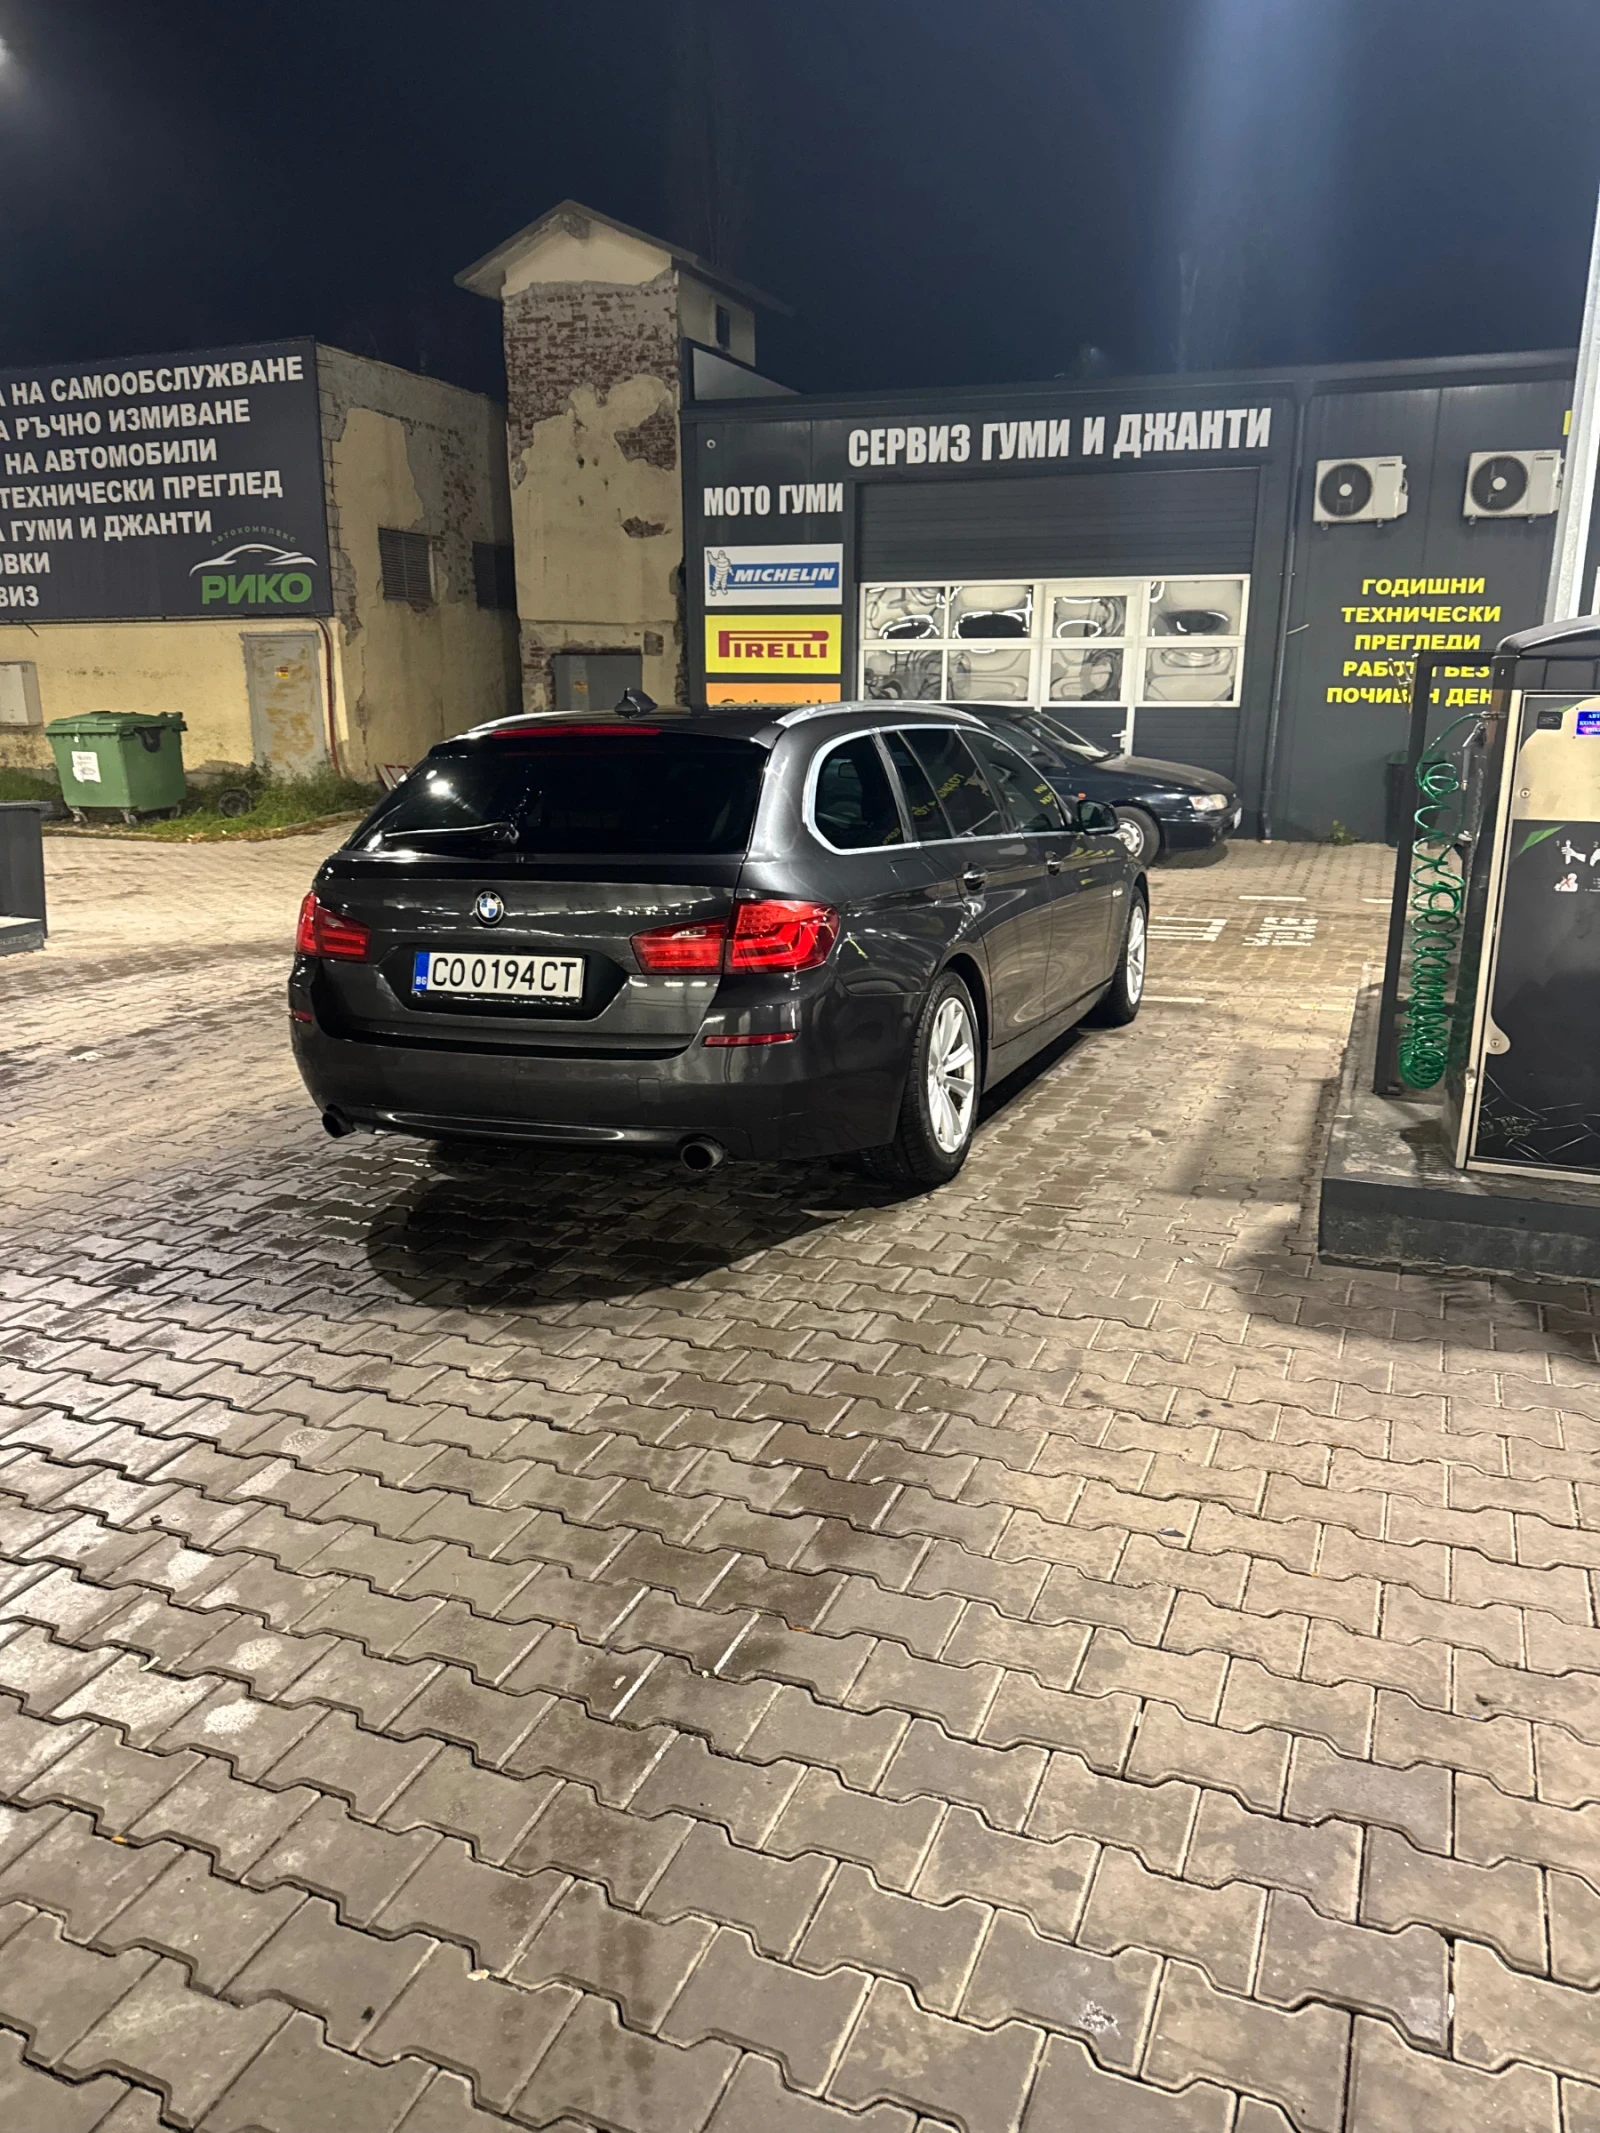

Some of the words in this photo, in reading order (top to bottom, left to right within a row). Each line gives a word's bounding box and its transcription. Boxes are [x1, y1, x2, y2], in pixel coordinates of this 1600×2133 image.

[11, 381, 46, 406] НА
[51, 356, 304, 402] САМООБСЛУЖВАНЕ
[15, 411, 102, 440] РЪЧНО
[108, 399, 251, 432] ИЗМИВАНЕ
[848, 424, 971, 467] СЕРВИЗ
[981, 419, 1070, 461] ГУМИ
[1082, 416, 1105, 456] И
[1113, 407, 1272, 460] ДЖАНТИ
[5, 452, 39, 475] НА
[45, 438, 218, 473] АВТОМОБИЛИ
[0, 478, 155, 509] ТЕХНИЧЕСКИ
[163, 470, 283, 500] ПРЕГЛЕД
[704, 485, 771, 516] МОТО
[778, 482, 844, 515] ГУМИ
[10, 518, 73, 542] ГУМИ
[79, 516, 97, 539] И
[104, 510, 212, 541] ДЖАНТИ
[211, 525, 296, 546] АВТОКОМПЛЕКС
[0, 552, 51, 575] ВКИ
[733, 567, 836, 582] MICHELIN
[202, 572, 313, 604] РИКО
[1362, 577, 1486, 598] ГОДИШНИ
[1341, 606, 1501, 623] ТЕХНИЧЕСКИ
[718, 630, 830, 658] PIRELLI
[1354, 634, 1481, 651] ПРЕГЛЕДИ
[1445, 688, 1492, 707] ДЕН
[416, 976, 427, 985] BG
